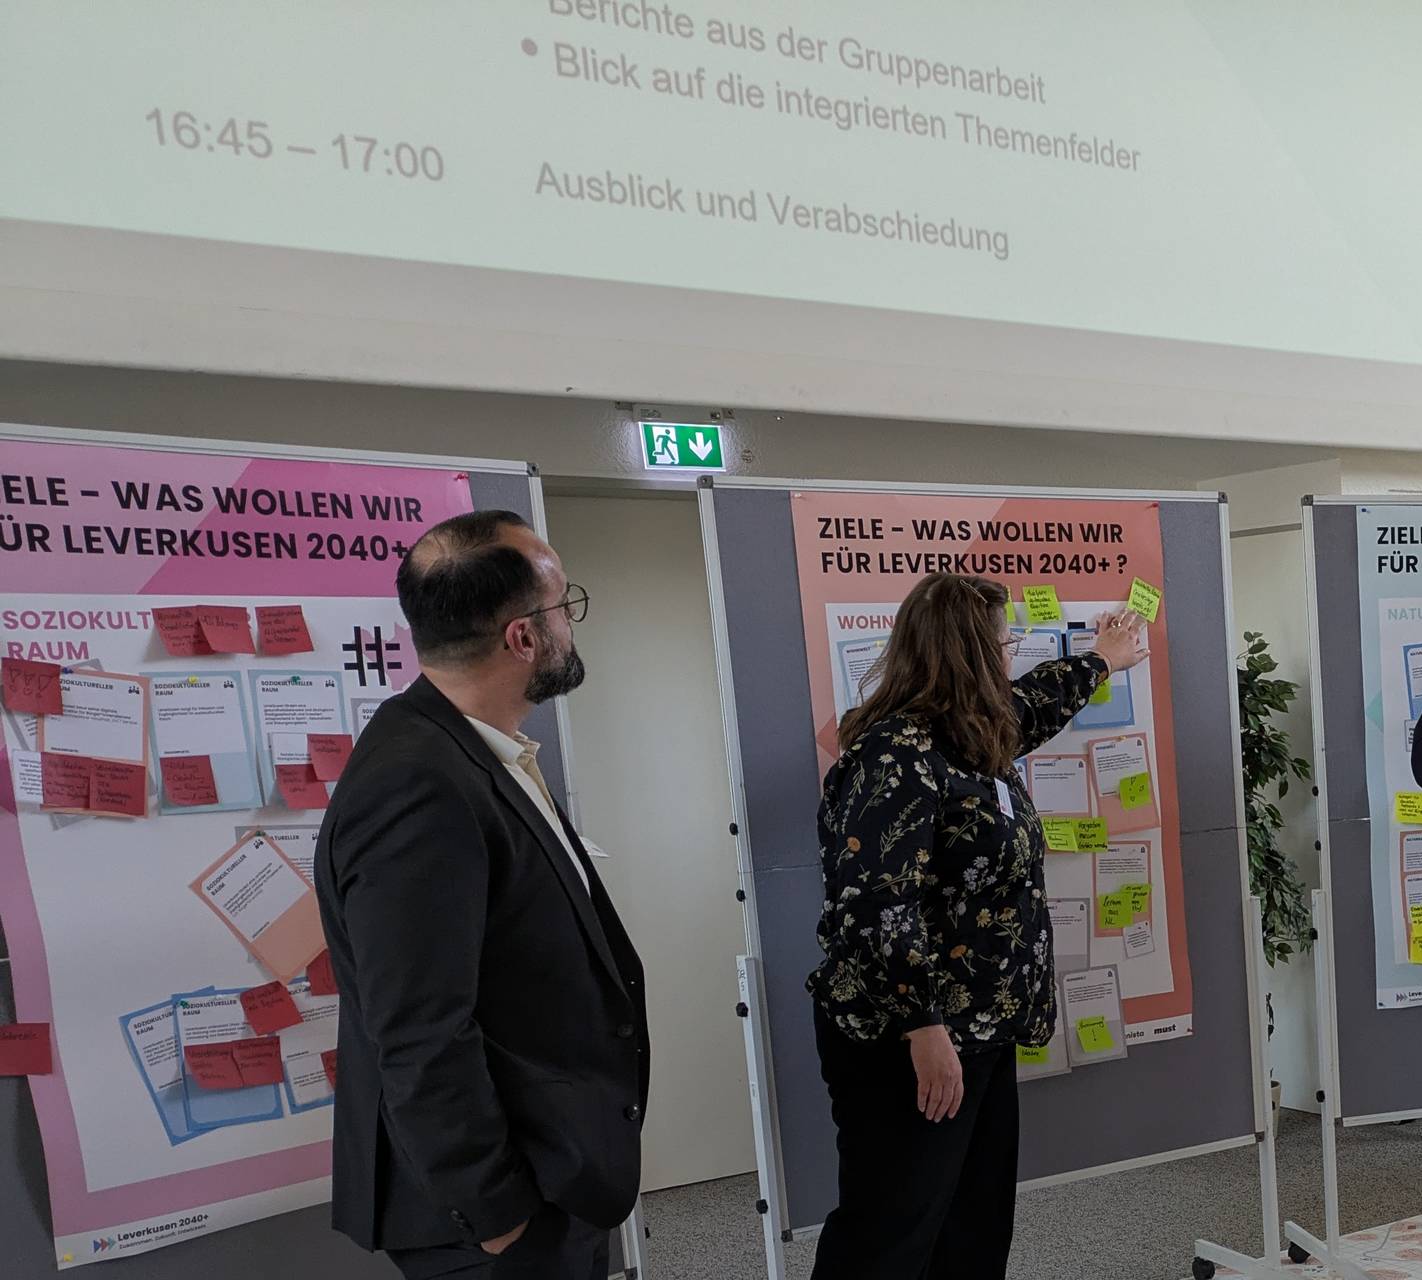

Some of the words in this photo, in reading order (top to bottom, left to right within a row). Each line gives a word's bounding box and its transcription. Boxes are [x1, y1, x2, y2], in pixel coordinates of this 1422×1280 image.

[706, 15, 766, 53] aus
[777, 27, 828, 64] der
[838, 37, 1046, 105] Gruppenarbeit
[554, 42, 642, 90] Blick
[652, 67, 706, 100] auf
[715, 72, 765, 110] die
[776, 81, 947, 141] integrierten
[954, 112, 1142, 172] Themenfelder
[145, 107, 274, 160] 16:45
[330, 132, 445, 184] 17:00
[535, 161, 686, 214] Ausblick
[696, 187, 758, 223] und
[766, 191, 1010, 261] Verabschiedung
[0, 475, 69, 506] ELE
[111, 481, 204, 512] WAS
[212, 486, 353, 519] WOLLEN
[360, 494, 423, 522] WIR
[62, 524, 298, 560] LEVERKUSEN
[306, 533, 408, 562] 2040+
[817, 517, 884, 540] ZIELE
[911, 519, 971, 541] WAS
[977, 520, 1073, 543] WOLLEN
[1079, 523, 1124, 543] WIR
[821, 546, 872, 574] FÜR
[878, 552, 1034, 574] LEVERKUSEN
[1039, 554, 1111, 575] 2040+
[1117, 554, 1128, 574] ?
[1377, 550, 1419, 574] FÜR
[2, 610, 152, 630] SOZIOKULT
[837, 615, 896, 630] WOHN
[7, 641, 90, 661] RAUM
[60, 679, 114, 690] ZIOKULTURELLER
[1126, 1030, 1145, 1040] nista
[1153, 1024, 1177, 1035] must
[117, 1221, 178, 1242] Leverkusen
[178, 1214, 209, 1228] 2040+
